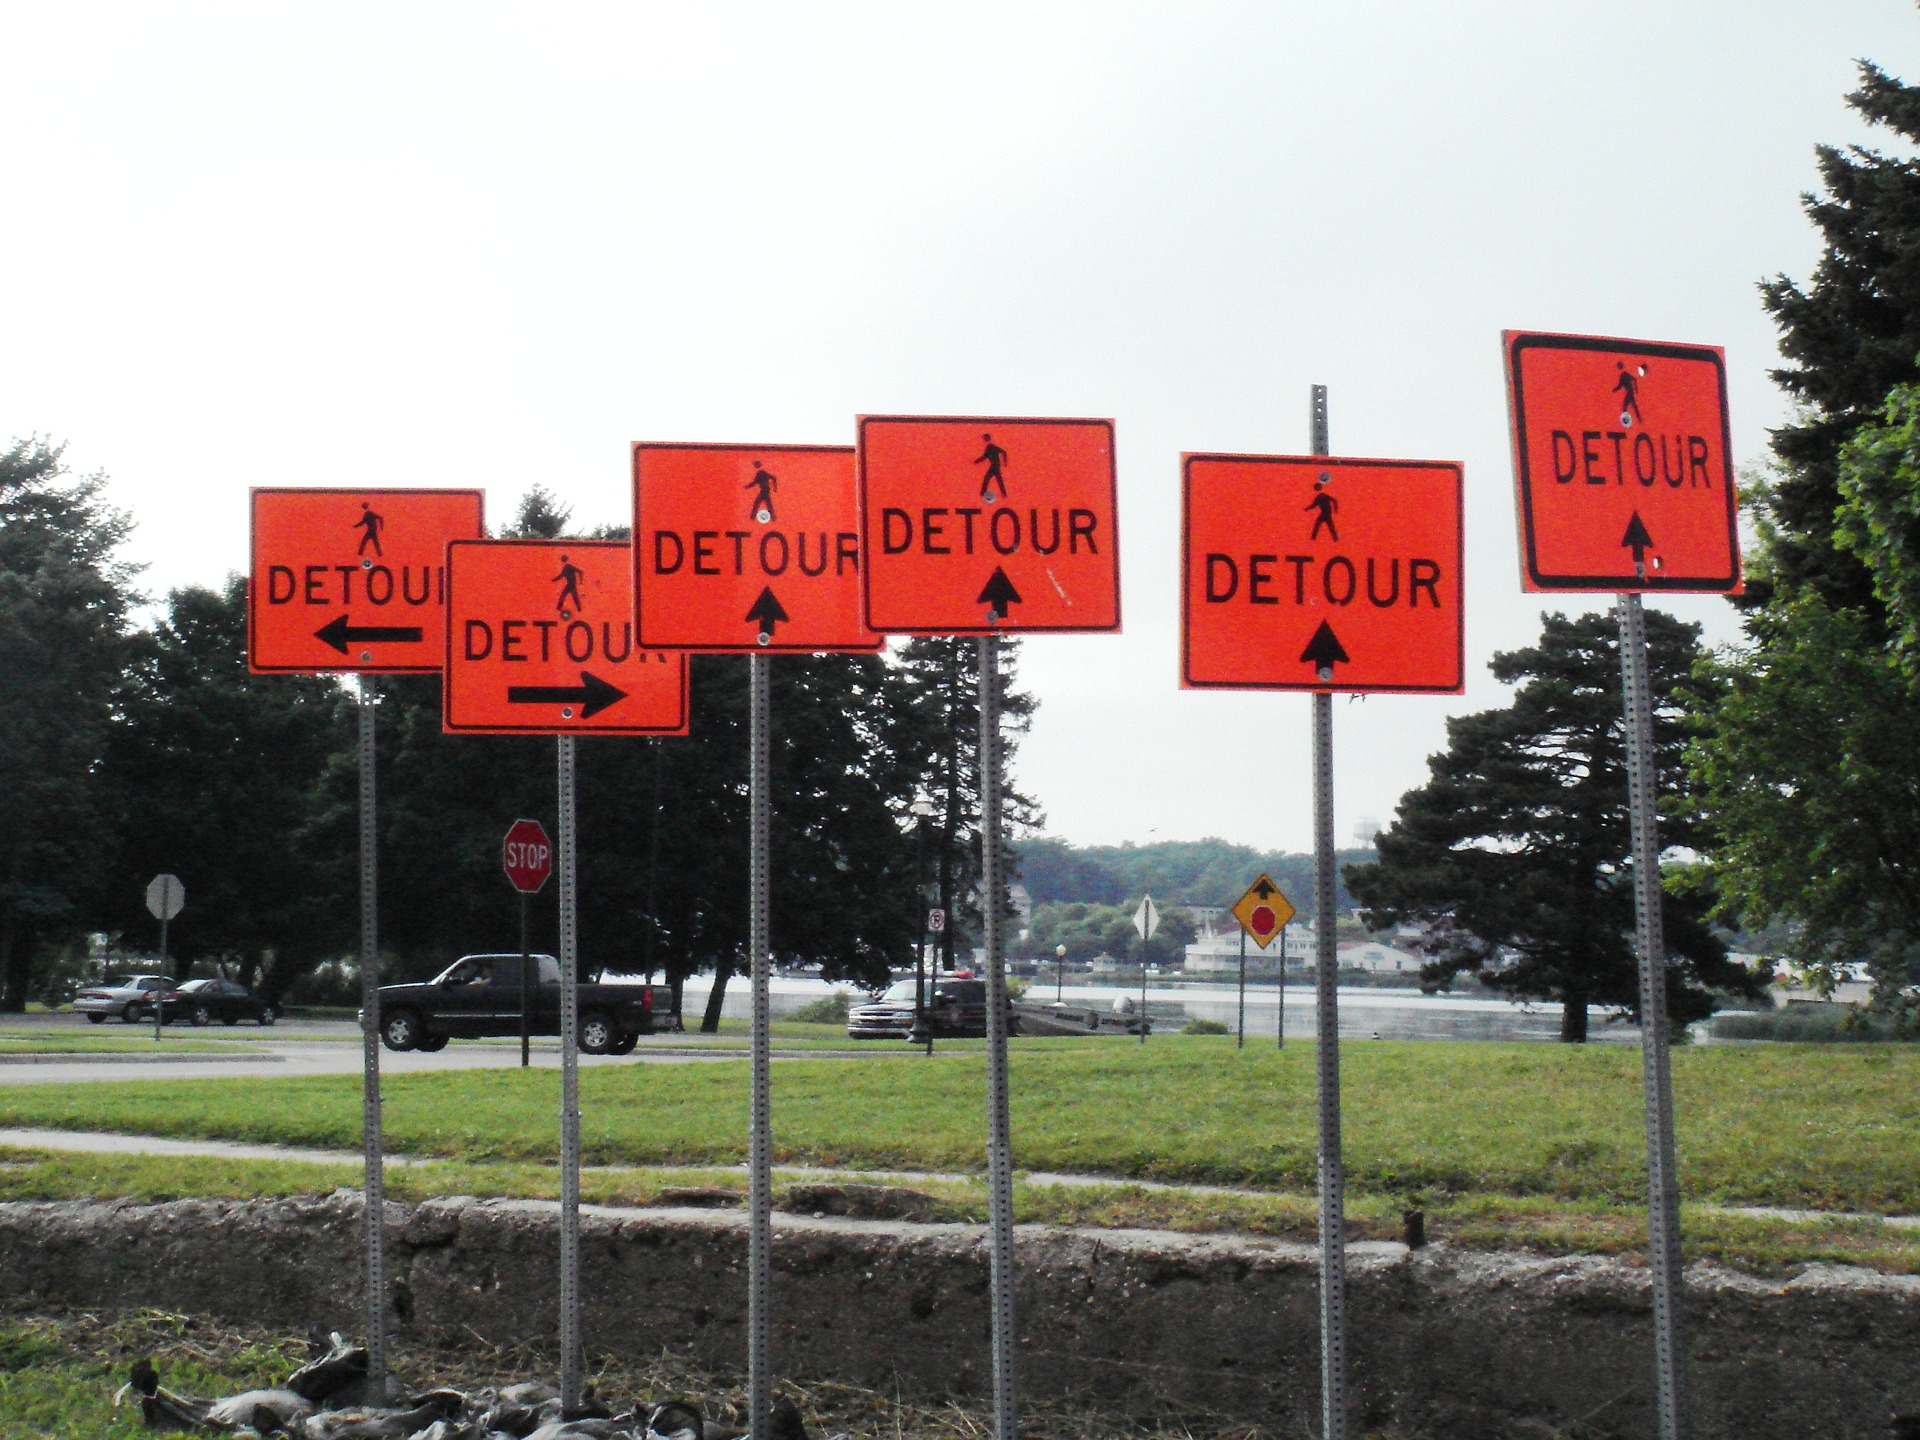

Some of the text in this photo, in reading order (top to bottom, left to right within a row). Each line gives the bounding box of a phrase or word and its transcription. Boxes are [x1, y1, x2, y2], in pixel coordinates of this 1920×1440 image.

[1551, 429, 1712, 488] DETOUR
[655, 531, 859, 576] DETOUR
[882, 507, 1098, 555] DETOUR
[269, 565, 444, 606] DETOU
[1206, 553, 1441, 608] DETOUR
[465, 619, 667, 663] DETOU
[507, 842, 548, 869] STOP
